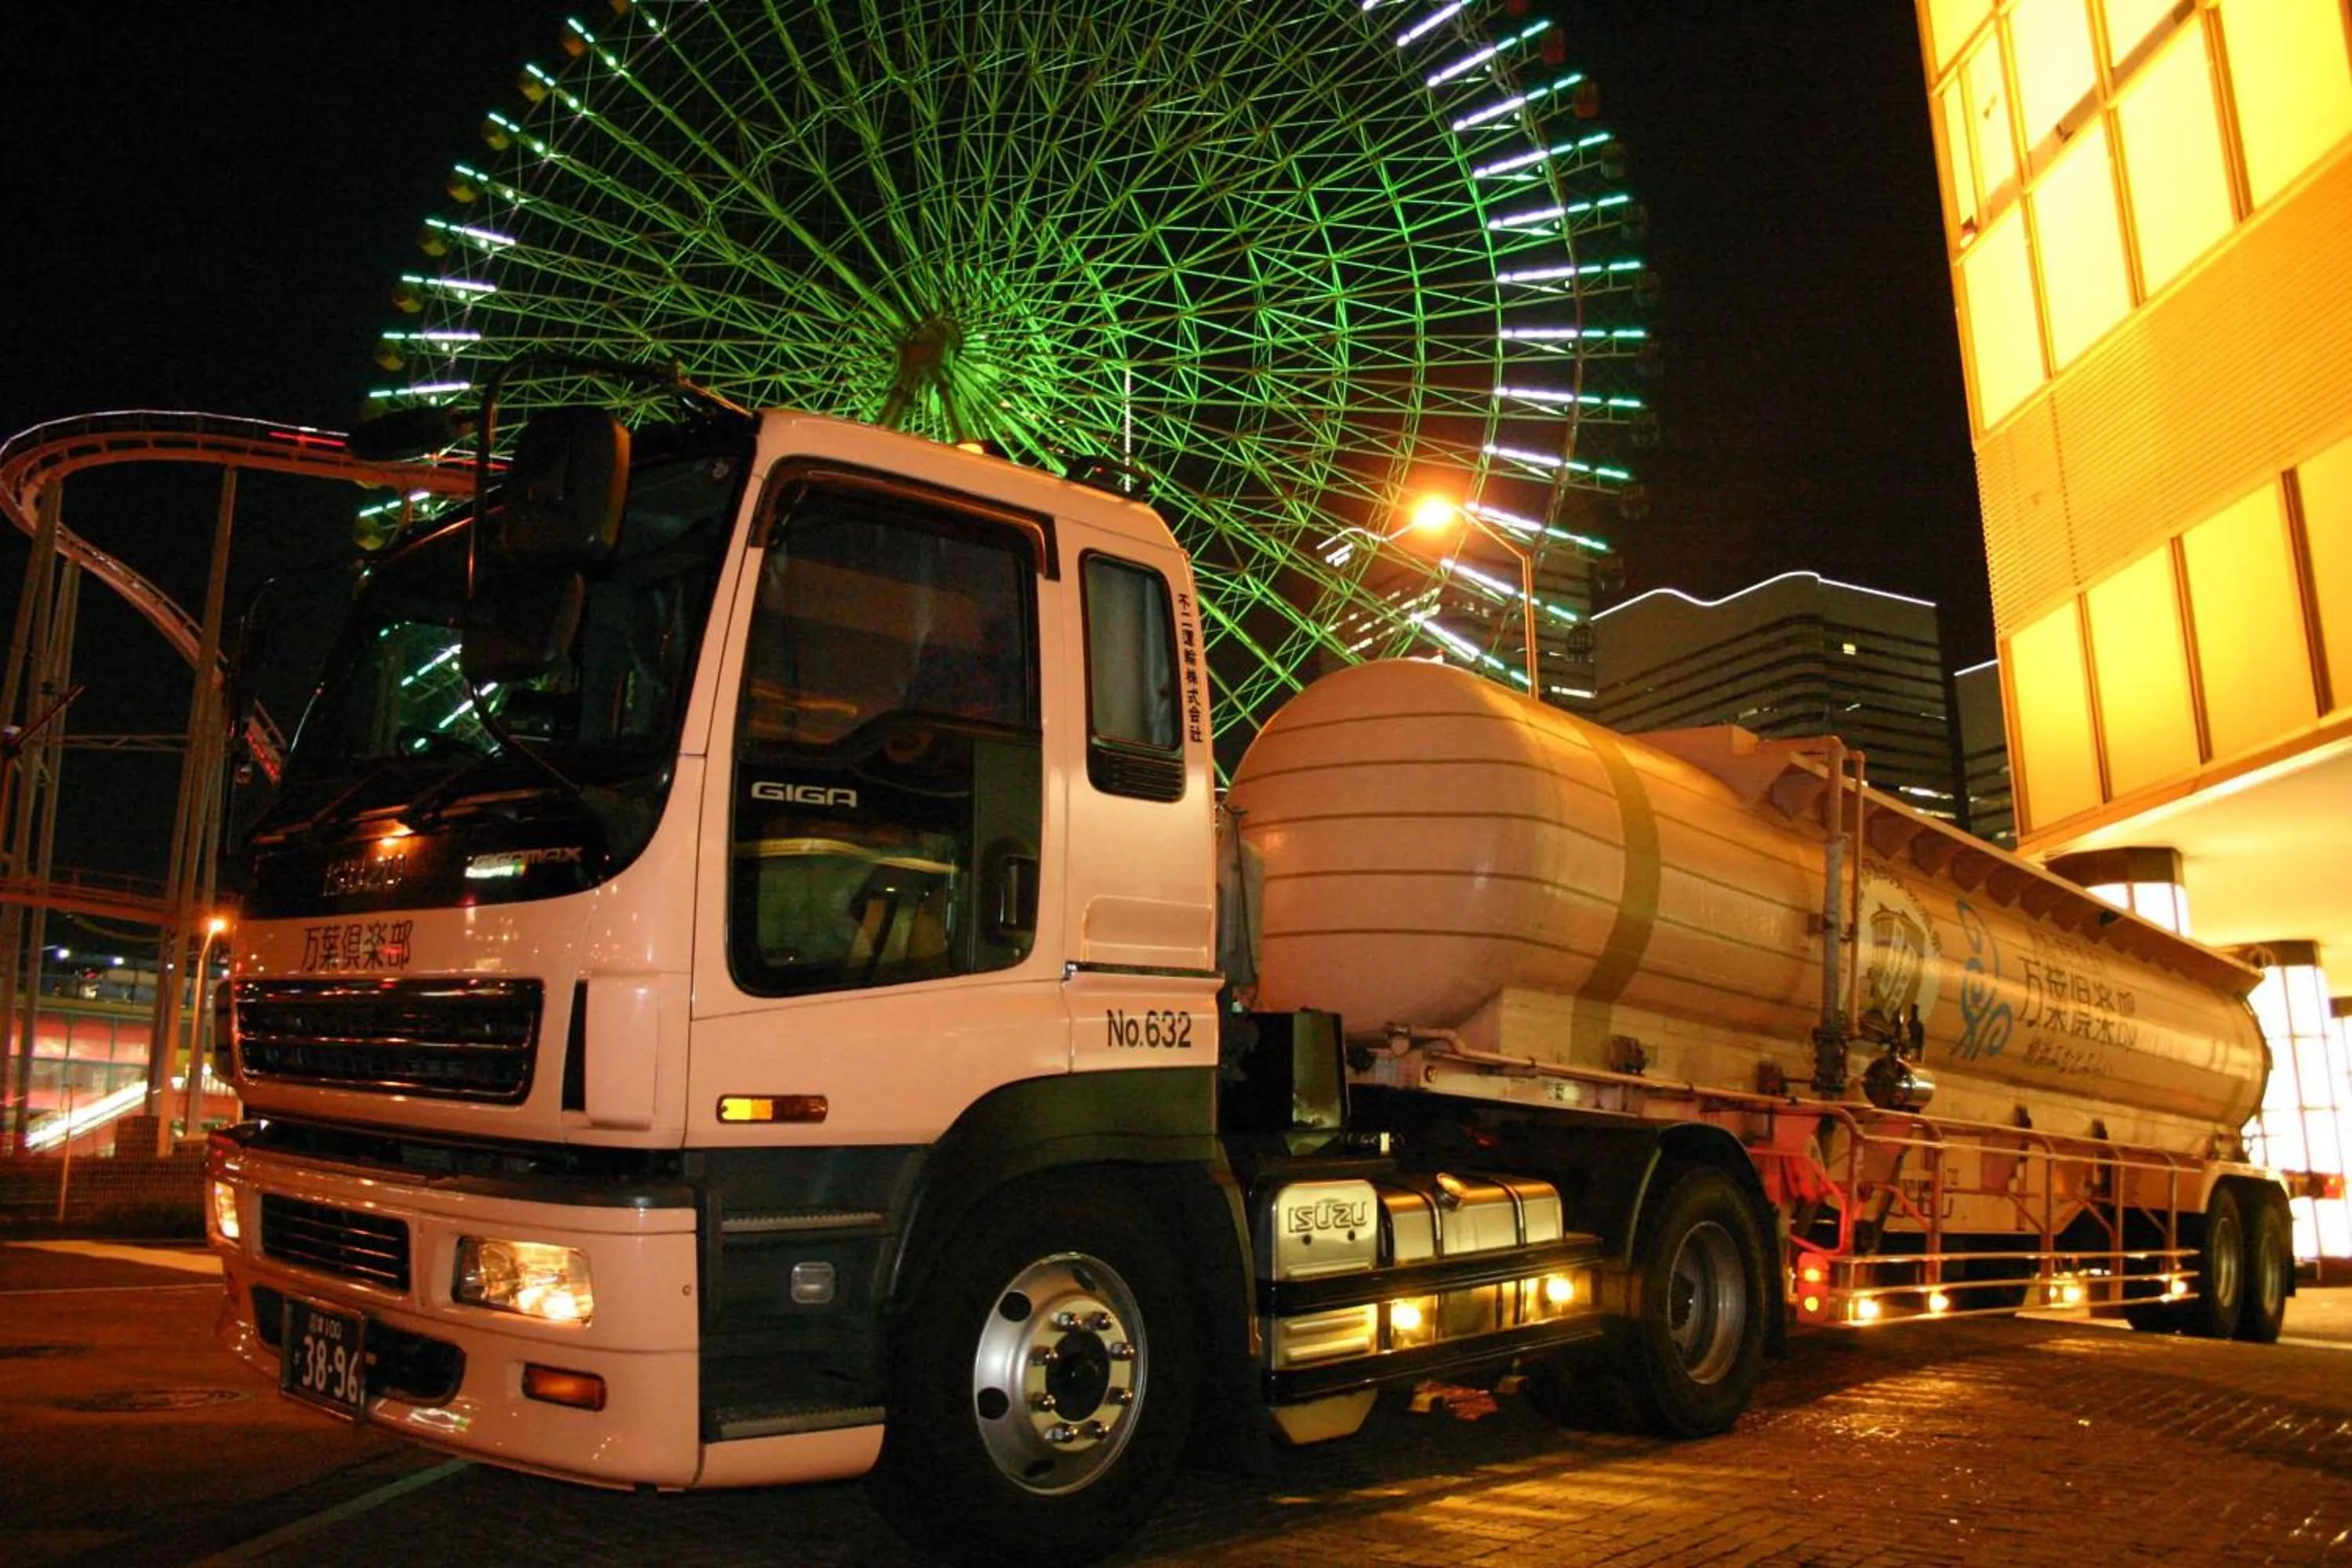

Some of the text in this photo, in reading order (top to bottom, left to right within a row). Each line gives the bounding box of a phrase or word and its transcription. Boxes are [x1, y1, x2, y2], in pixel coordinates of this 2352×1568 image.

[751, 781, 857, 808] GIGA
[301, 920, 414, 971] 万葉倶楽部
[1106, 1009, 1192, 1048] No.632
[1288, 1202, 1367, 1233] ISUZU
